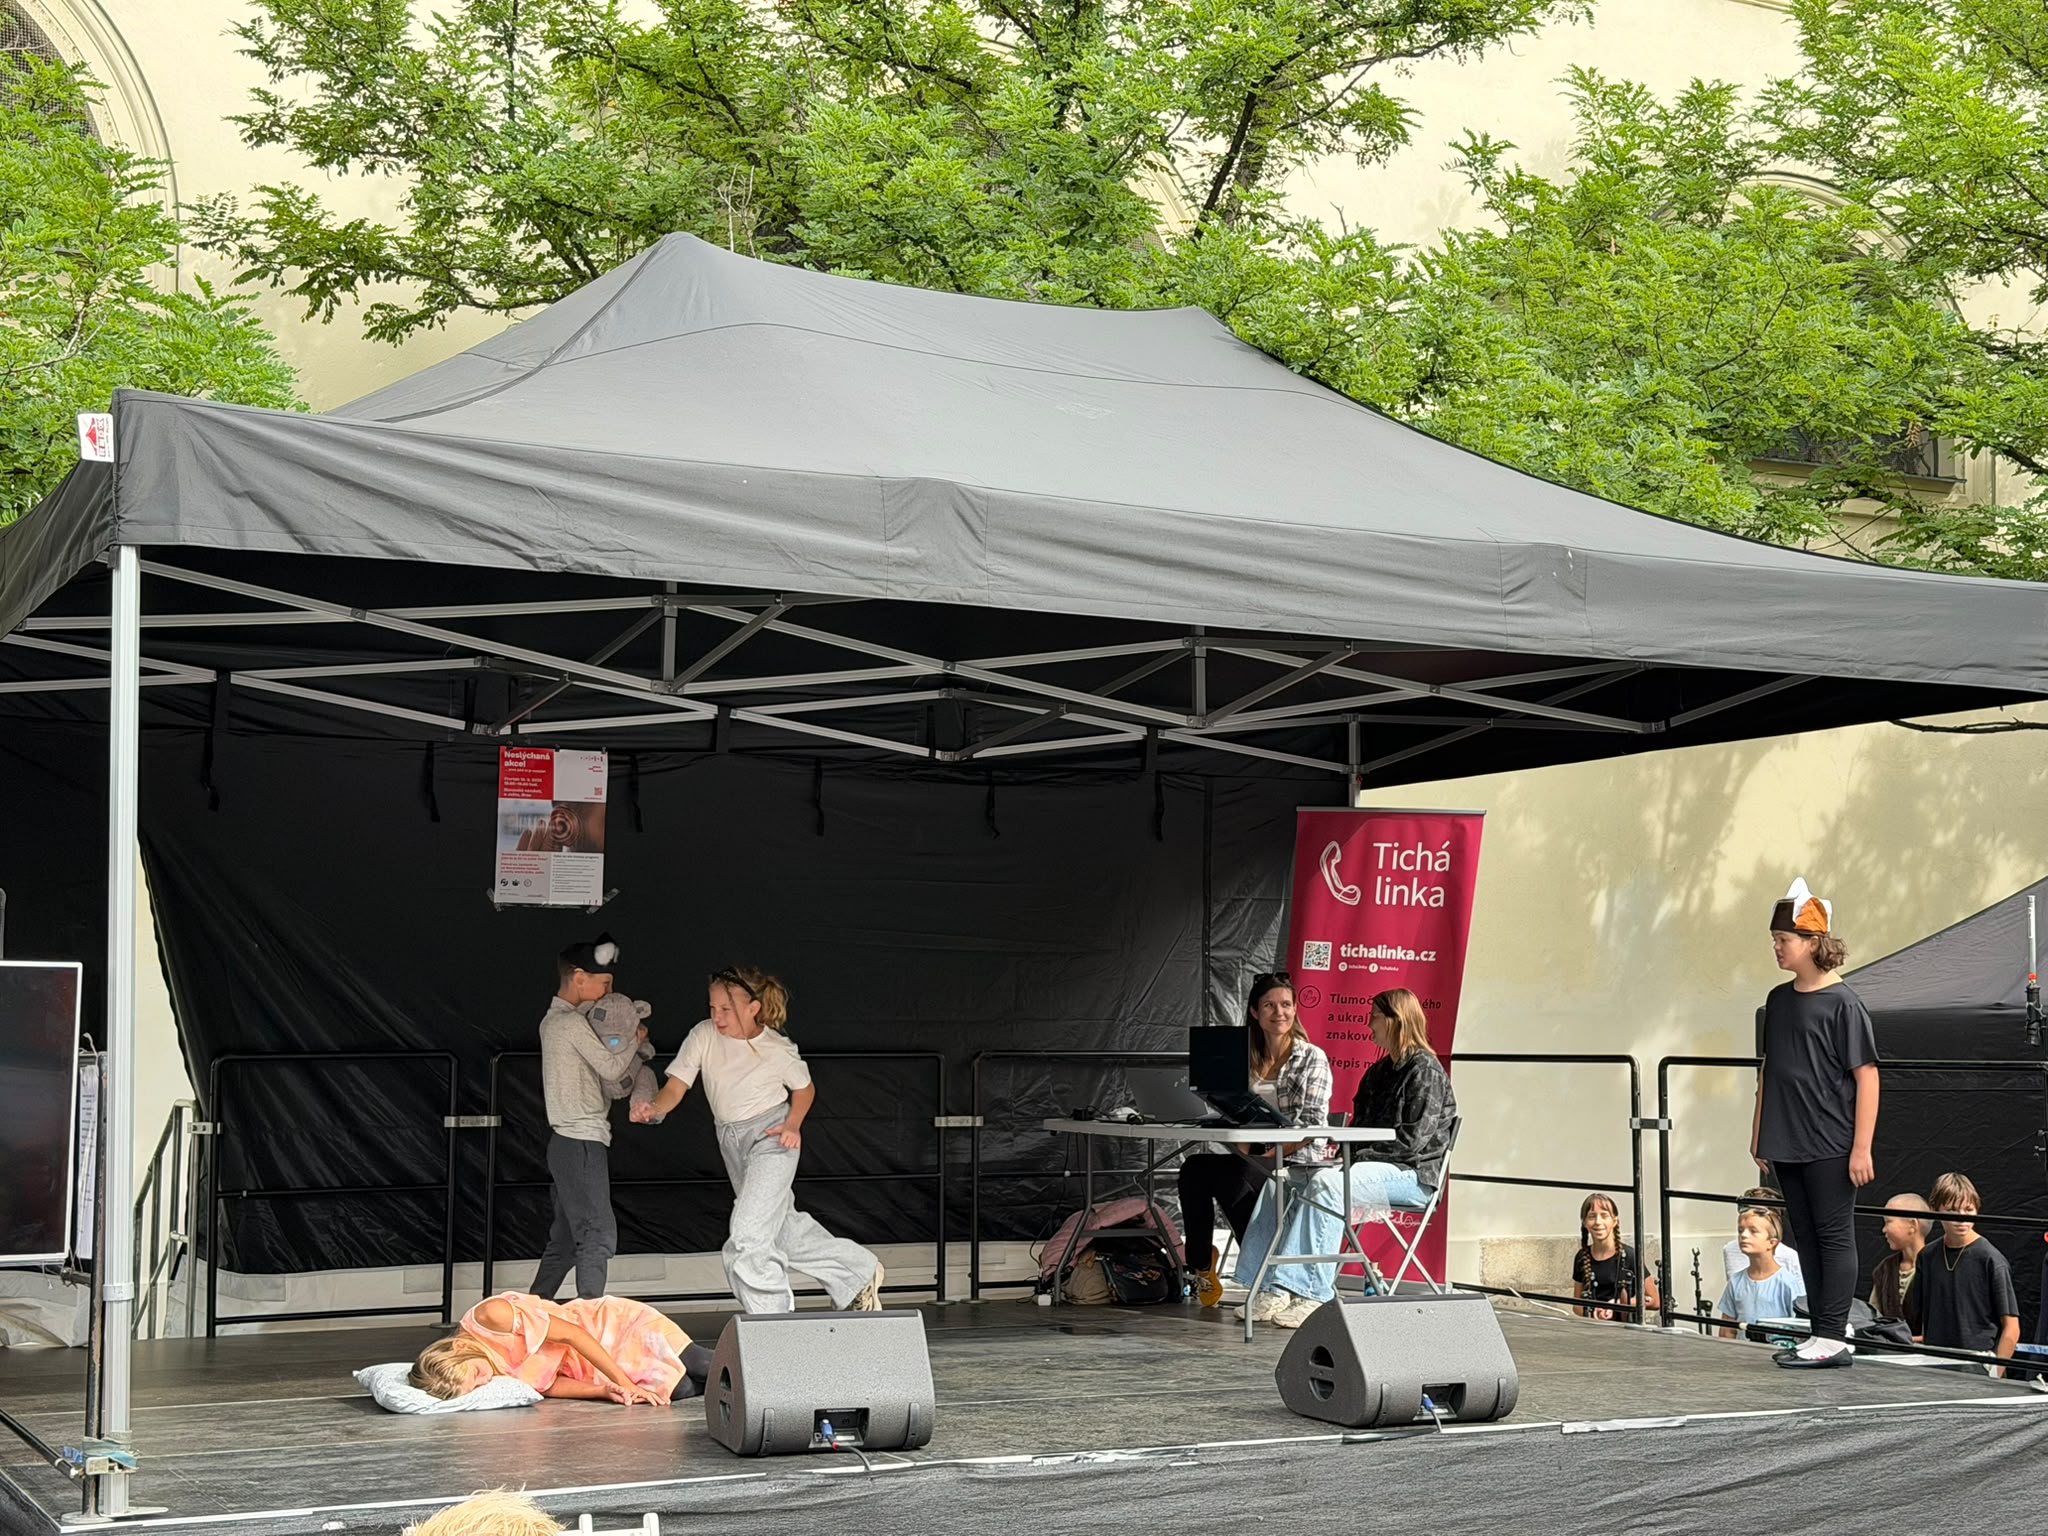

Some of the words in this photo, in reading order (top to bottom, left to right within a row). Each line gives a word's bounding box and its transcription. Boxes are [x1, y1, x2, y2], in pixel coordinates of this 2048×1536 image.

[504, 751, 550, 761] Neslýchaná
[1373, 840, 1451, 872] Tichá
[1375, 875, 1445, 908] linka
[1340, 943, 1437, 962] tichalinka.cz
[1329, 993, 1374, 1005] Tlumoč
[1422, 998, 1441, 1009] ého
[1327, 1013, 1335, 1022] a
[1338, 1012, 1372, 1026] ukraj
